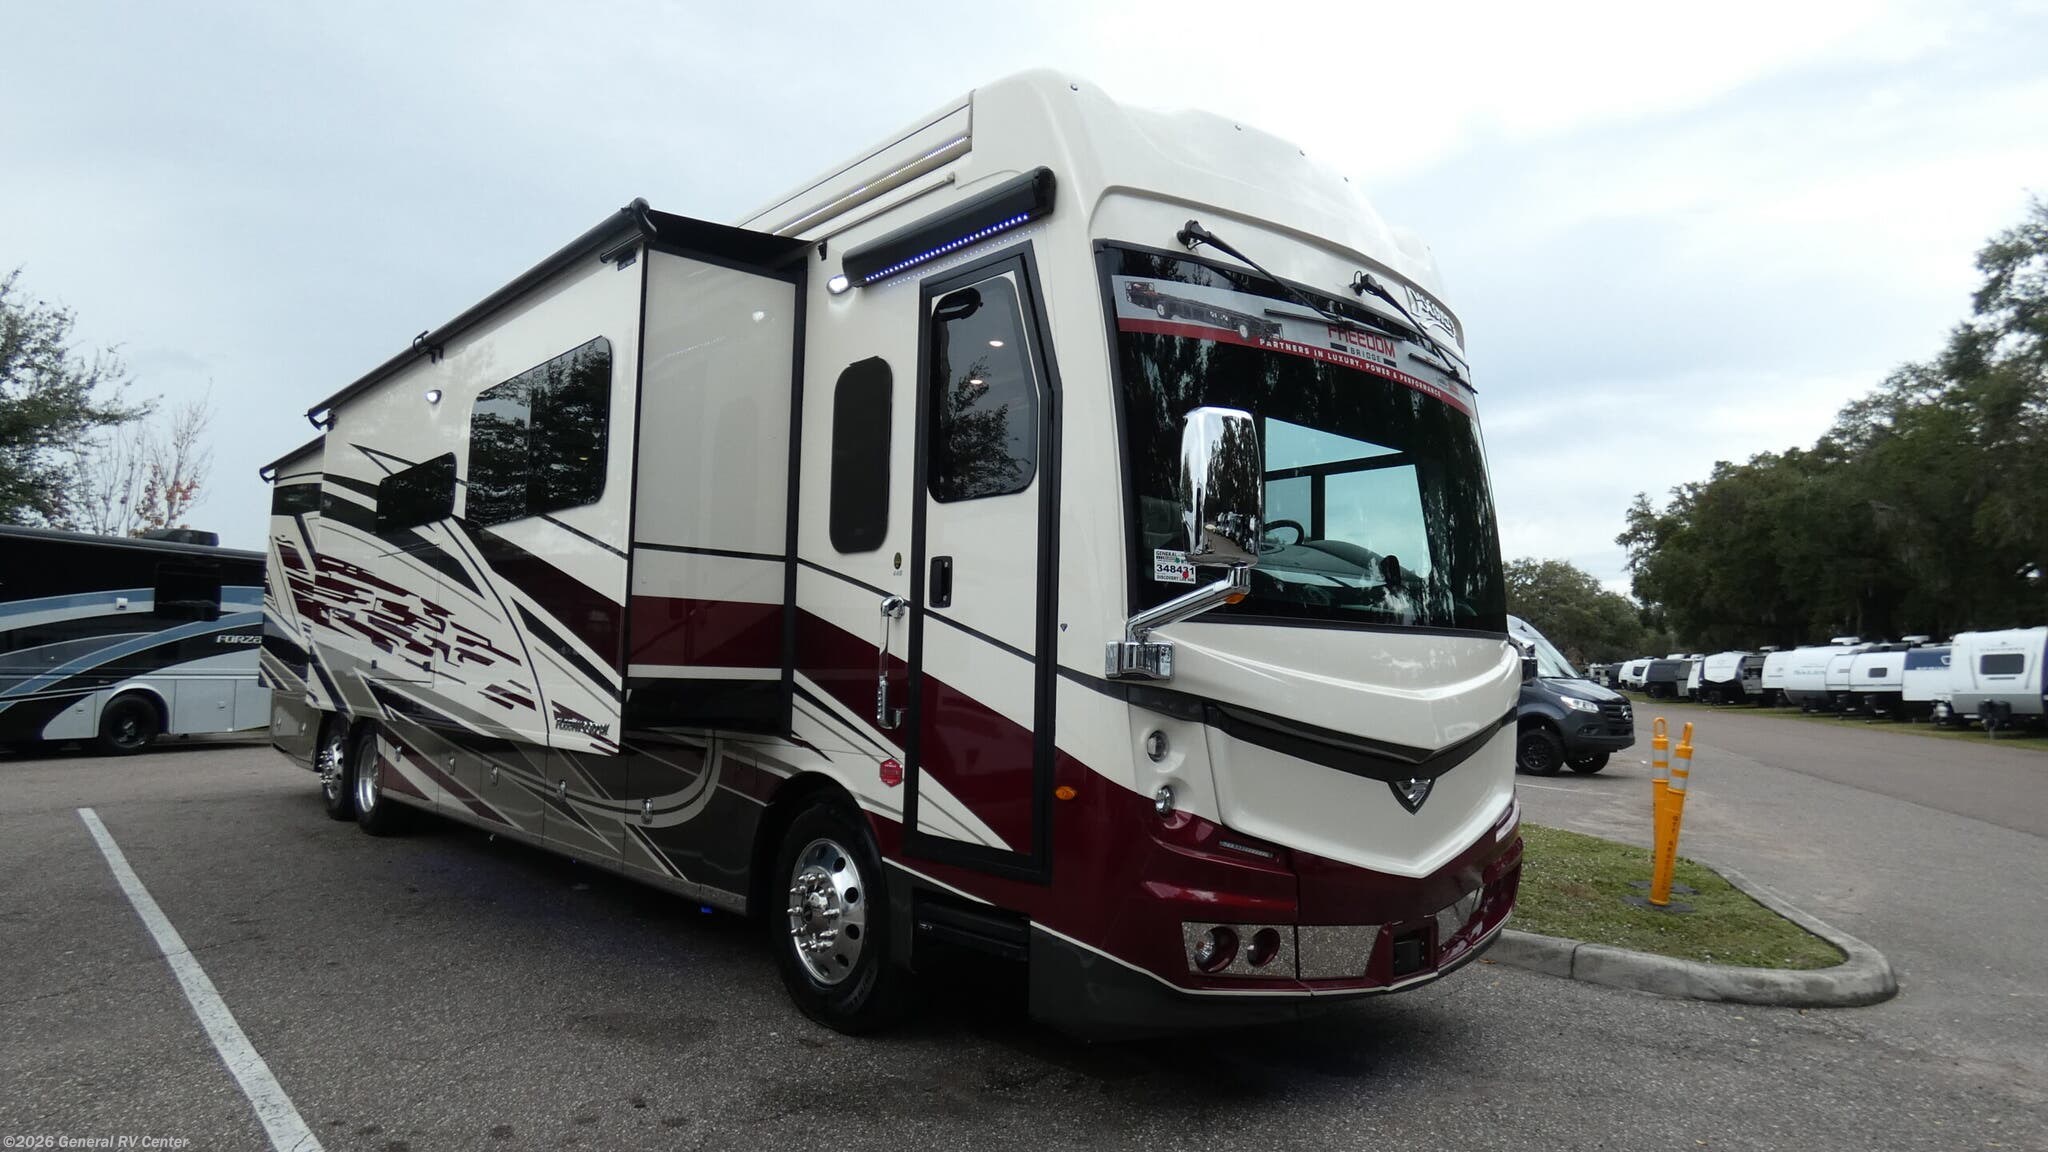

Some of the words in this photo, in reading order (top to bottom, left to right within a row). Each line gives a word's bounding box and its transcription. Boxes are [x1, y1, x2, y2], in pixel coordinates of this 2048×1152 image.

[1350, 347, 1384, 363] BRIDGE
[1259, 338, 1310, 358] PARTNERS
[1314, 349, 1324, 359] IN
[1327, 352, 1362, 369] LUXURY,
[1365, 362, 1391, 377] POWER
[1399, 374, 1441, 398] PERFORMANCE
[1156, 564, 1194, 575] 348431
